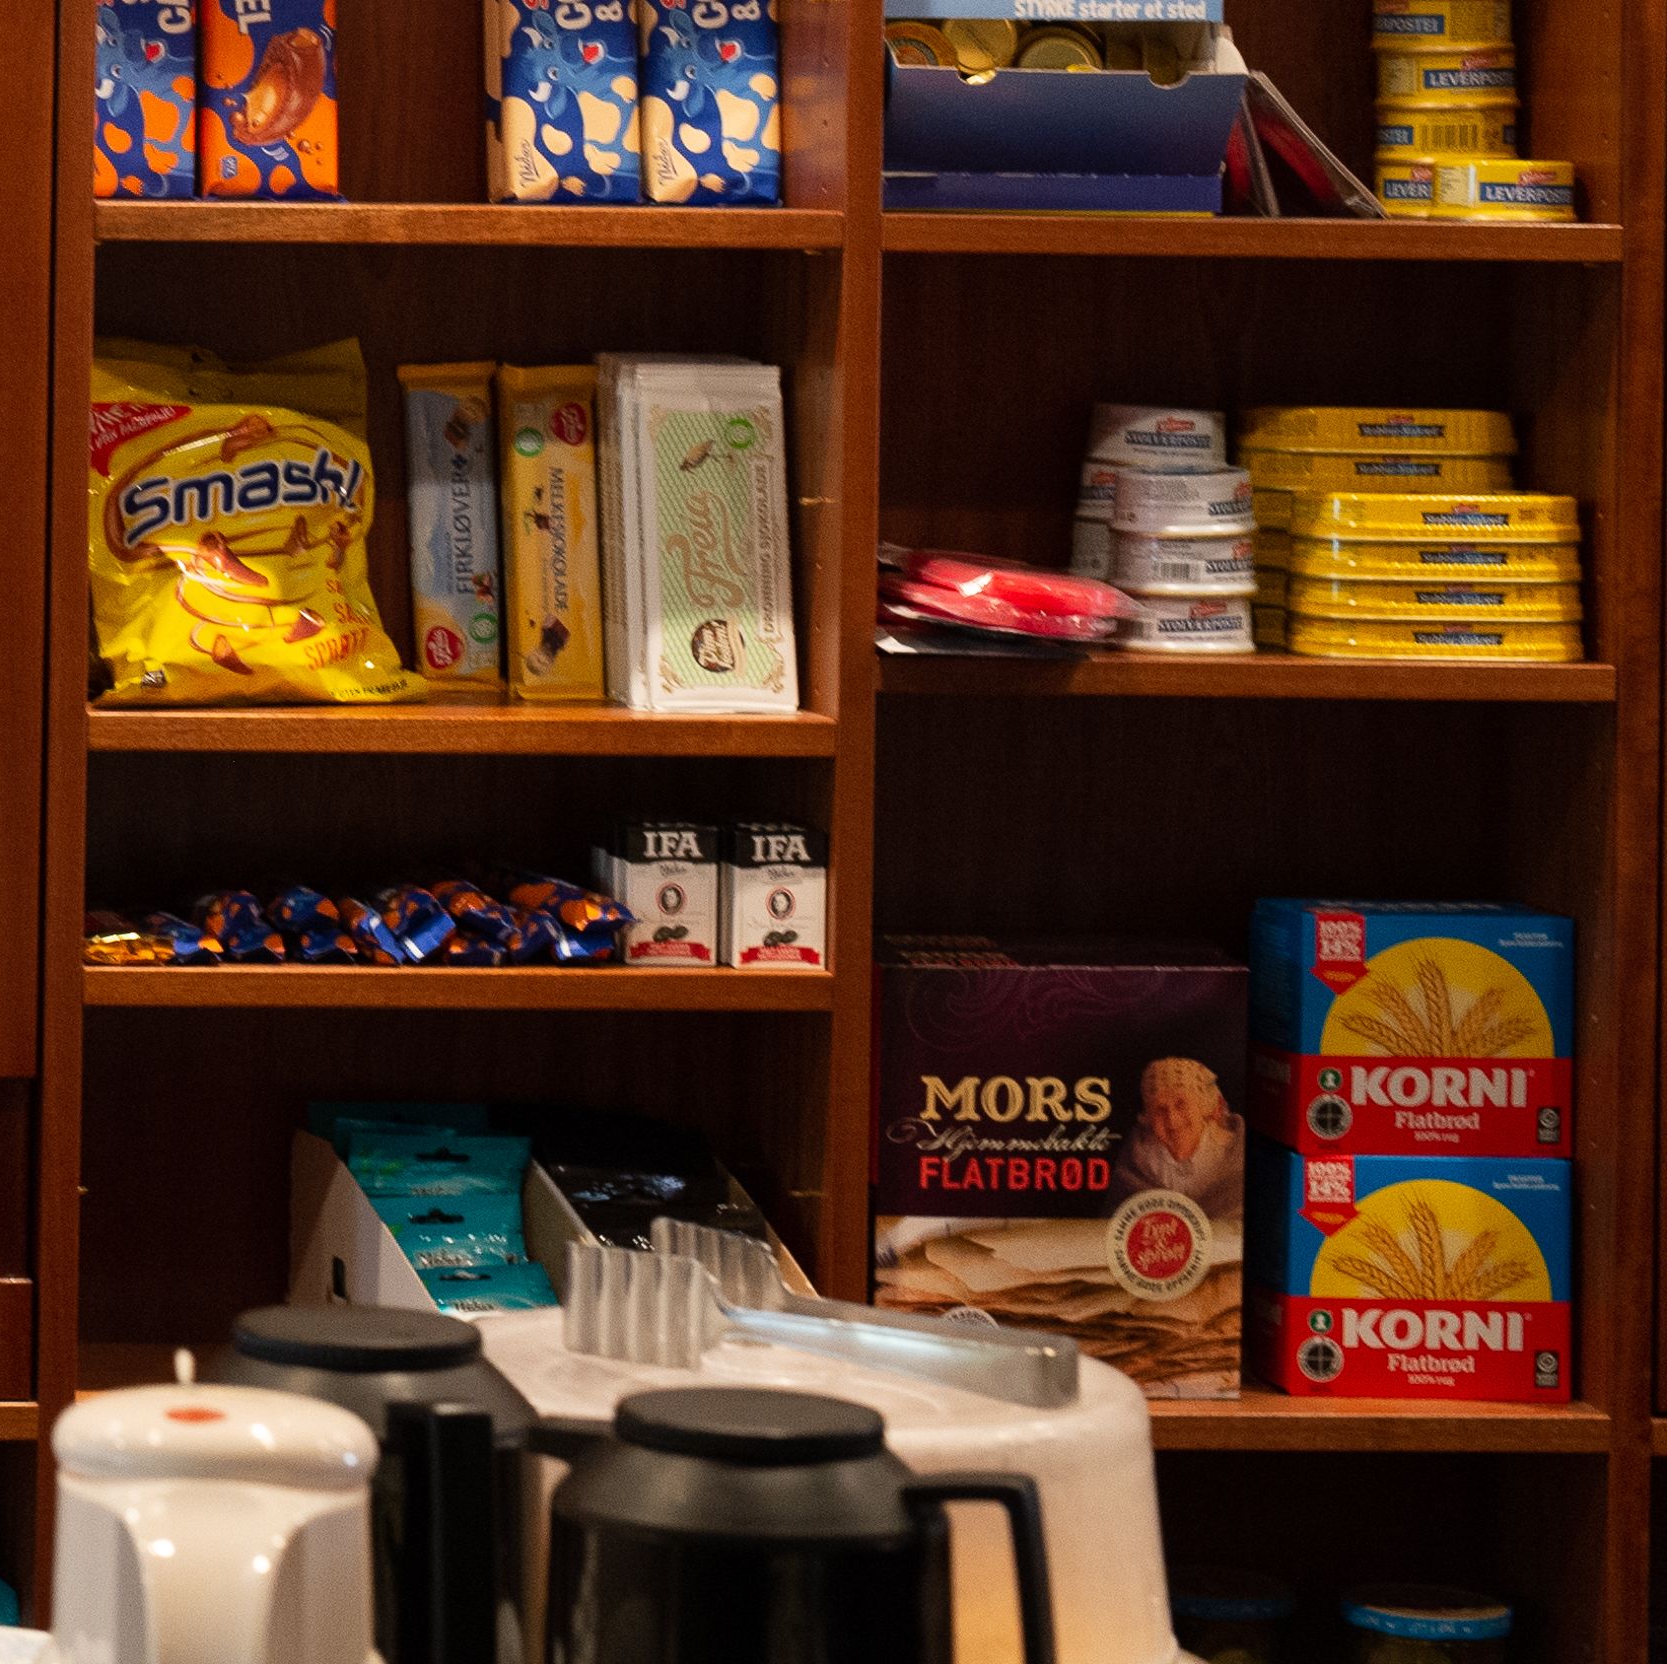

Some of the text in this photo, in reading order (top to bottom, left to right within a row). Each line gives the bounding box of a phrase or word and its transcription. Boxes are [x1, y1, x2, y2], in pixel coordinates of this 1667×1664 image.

[593, 1, 625, 23] &
[731, 0, 762, 23] &
[1080, 0, 1140, 19] starter
[1145, 0, 1163, 19] et
[1168, 0, 1206, 19] sted
[123, 449, 361, 547] Smash!
[450, 472, 476, 596] FIRKLØVER
[665, 488, 747, 610] Freia
[643, 831, 701, 859] IFA
[752, 835, 806, 862] IFA
[920, 1075, 1113, 1123] MORS
[1350, 1066, 1528, 1109] KORNI
[1395, 1110, 1481, 1131] Flatbrød
[919, 1156, 1111, 1192] FLATBRØD
[1341, 1307, 1525, 1352] KORNI
[1387, 1353, 1476, 1375] Flatbrød
